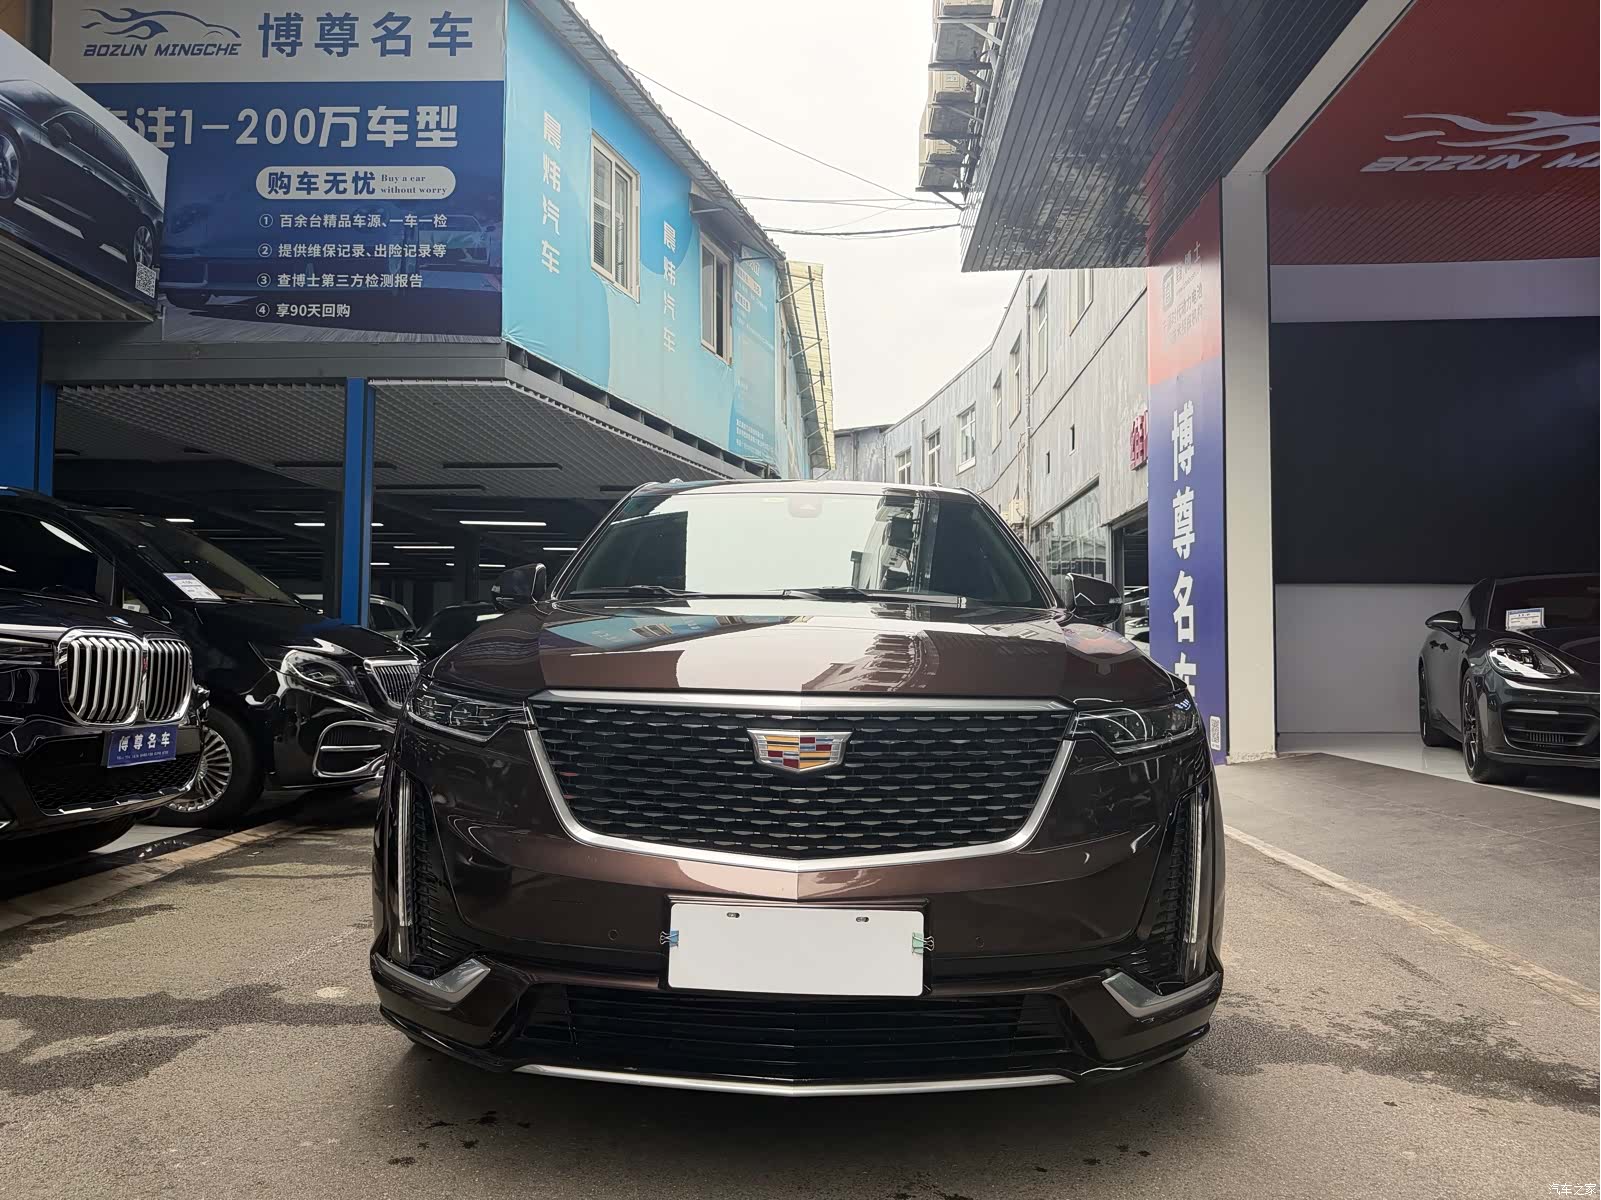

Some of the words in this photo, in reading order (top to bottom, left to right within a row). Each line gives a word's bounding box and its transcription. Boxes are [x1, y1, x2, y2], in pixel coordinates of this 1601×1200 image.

[258, 10, 473, 58] 博尊名车
[83, 43, 148, 57] BOZUN
[154, 43, 242, 57] MINGCHE
[1359, 153, 1542, 173] BOZUN
[267, 171, 376, 195] 购车无忧
[381, 174, 400, 184] Buy
[380, 186, 416, 194] without
[419, 187, 448, 195] worry
[279, 214, 448, 228] 百余台精品车源、一车一检
[278, 243, 447, 258] 提供维保记录、出险记录等
[277, 273, 423, 288] 查博士第三方检测报告
[276, 303, 350, 318] 享90天回购
